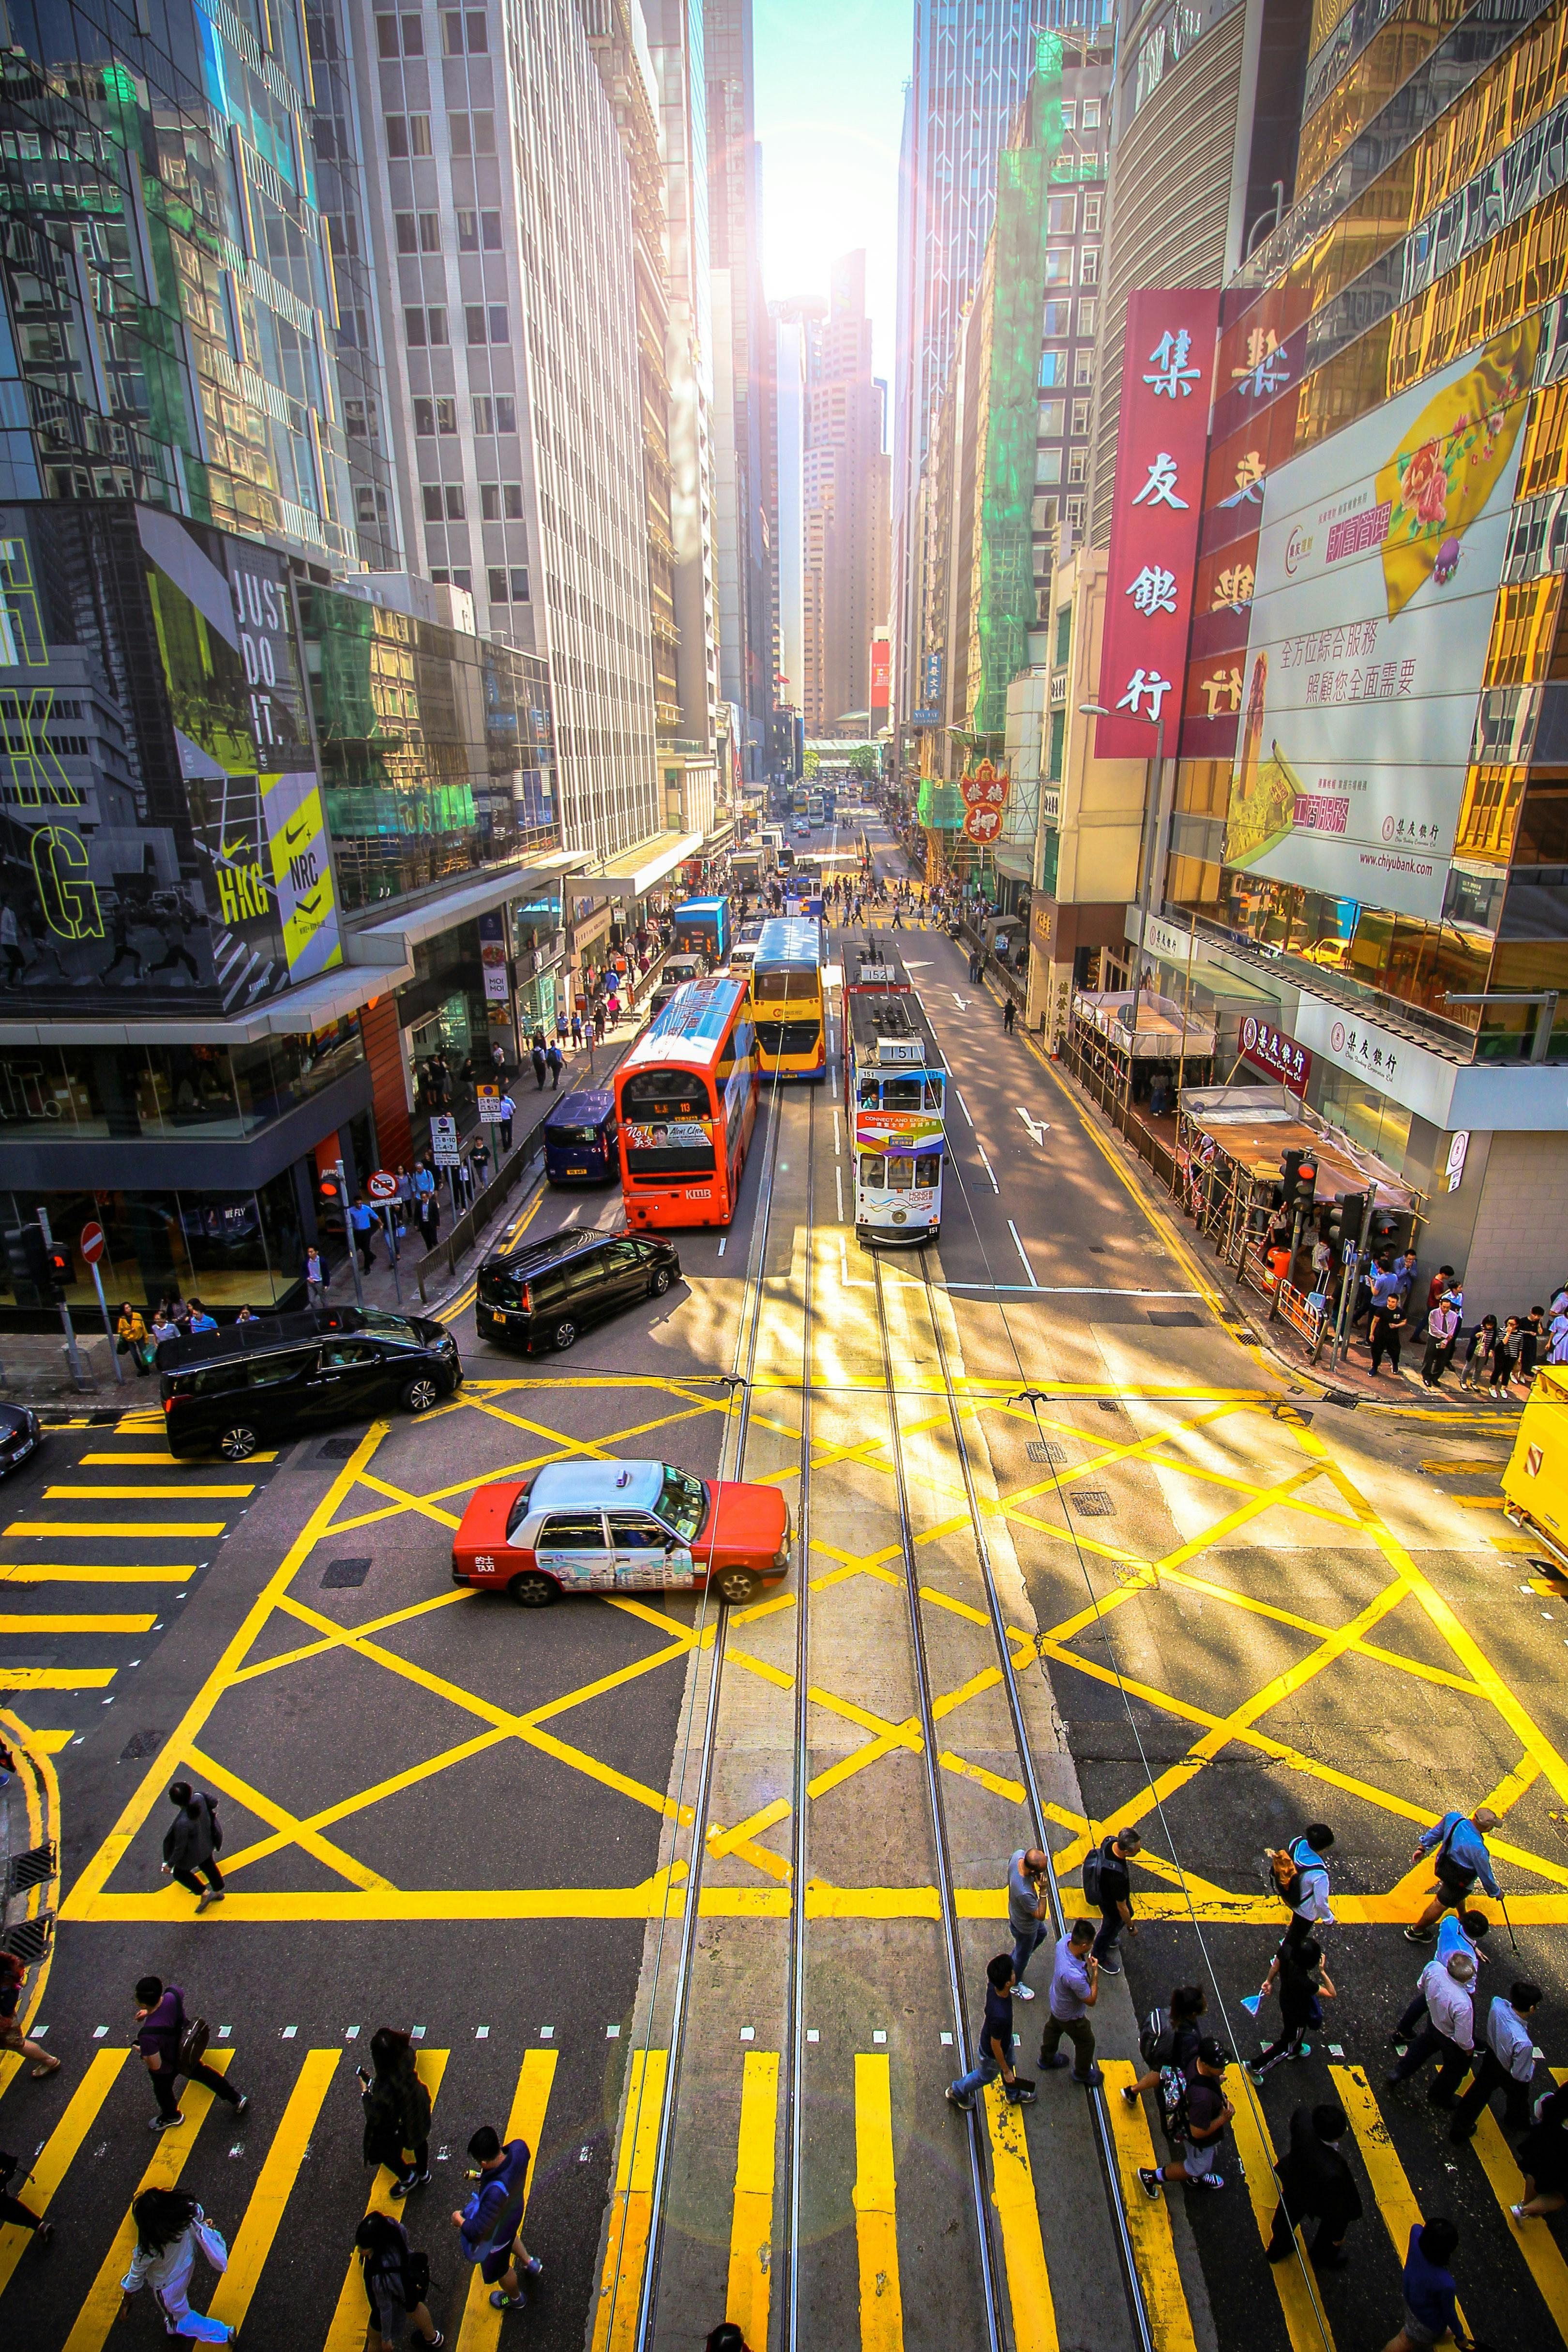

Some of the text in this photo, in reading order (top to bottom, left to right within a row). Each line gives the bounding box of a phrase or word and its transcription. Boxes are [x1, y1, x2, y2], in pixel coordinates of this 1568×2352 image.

[1116, 328, 1201, 722] 集友銀行
[1327, 501, 1391, 562] 財富管理
[234, 570, 289, 633] JUST
[241, 633, 276, 688] DO
[1281, 620, 1379, 669] 全方位綜合服務
[1306, 659, 1417, 704] 照顧您全面需要
[250, 694, 283, 745] IT.
[969, 809, 998, 838] 押
[1293, 794, 1349, 833] 工商服務
[1396, 818, 1439, 841] 集友銀行
[289, 852, 319, 891] NRC
[1360, 853, 1432, 876] www.chiyubank.com
[216, 862, 270, 924] HKG
[869, 971, 887, 980] 152
[891, 1047, 914, 1058] 151
[1258, 1025, 1304, 1073] 集友銀行
[1347, 1031, 1397, 1075] 集友銀行
[680, 1103, 690, 1113] 113
[626, 1126, 649, 1138] No.1
[634, 1137, 654, 1148] 英文
[670, 1127, 686, 1135] Alan
[685, 1189, 711, 1200] KMB
[225, 1208, 245, 1219] WE FLY
[475, 1555, 494, 1565] 的士
